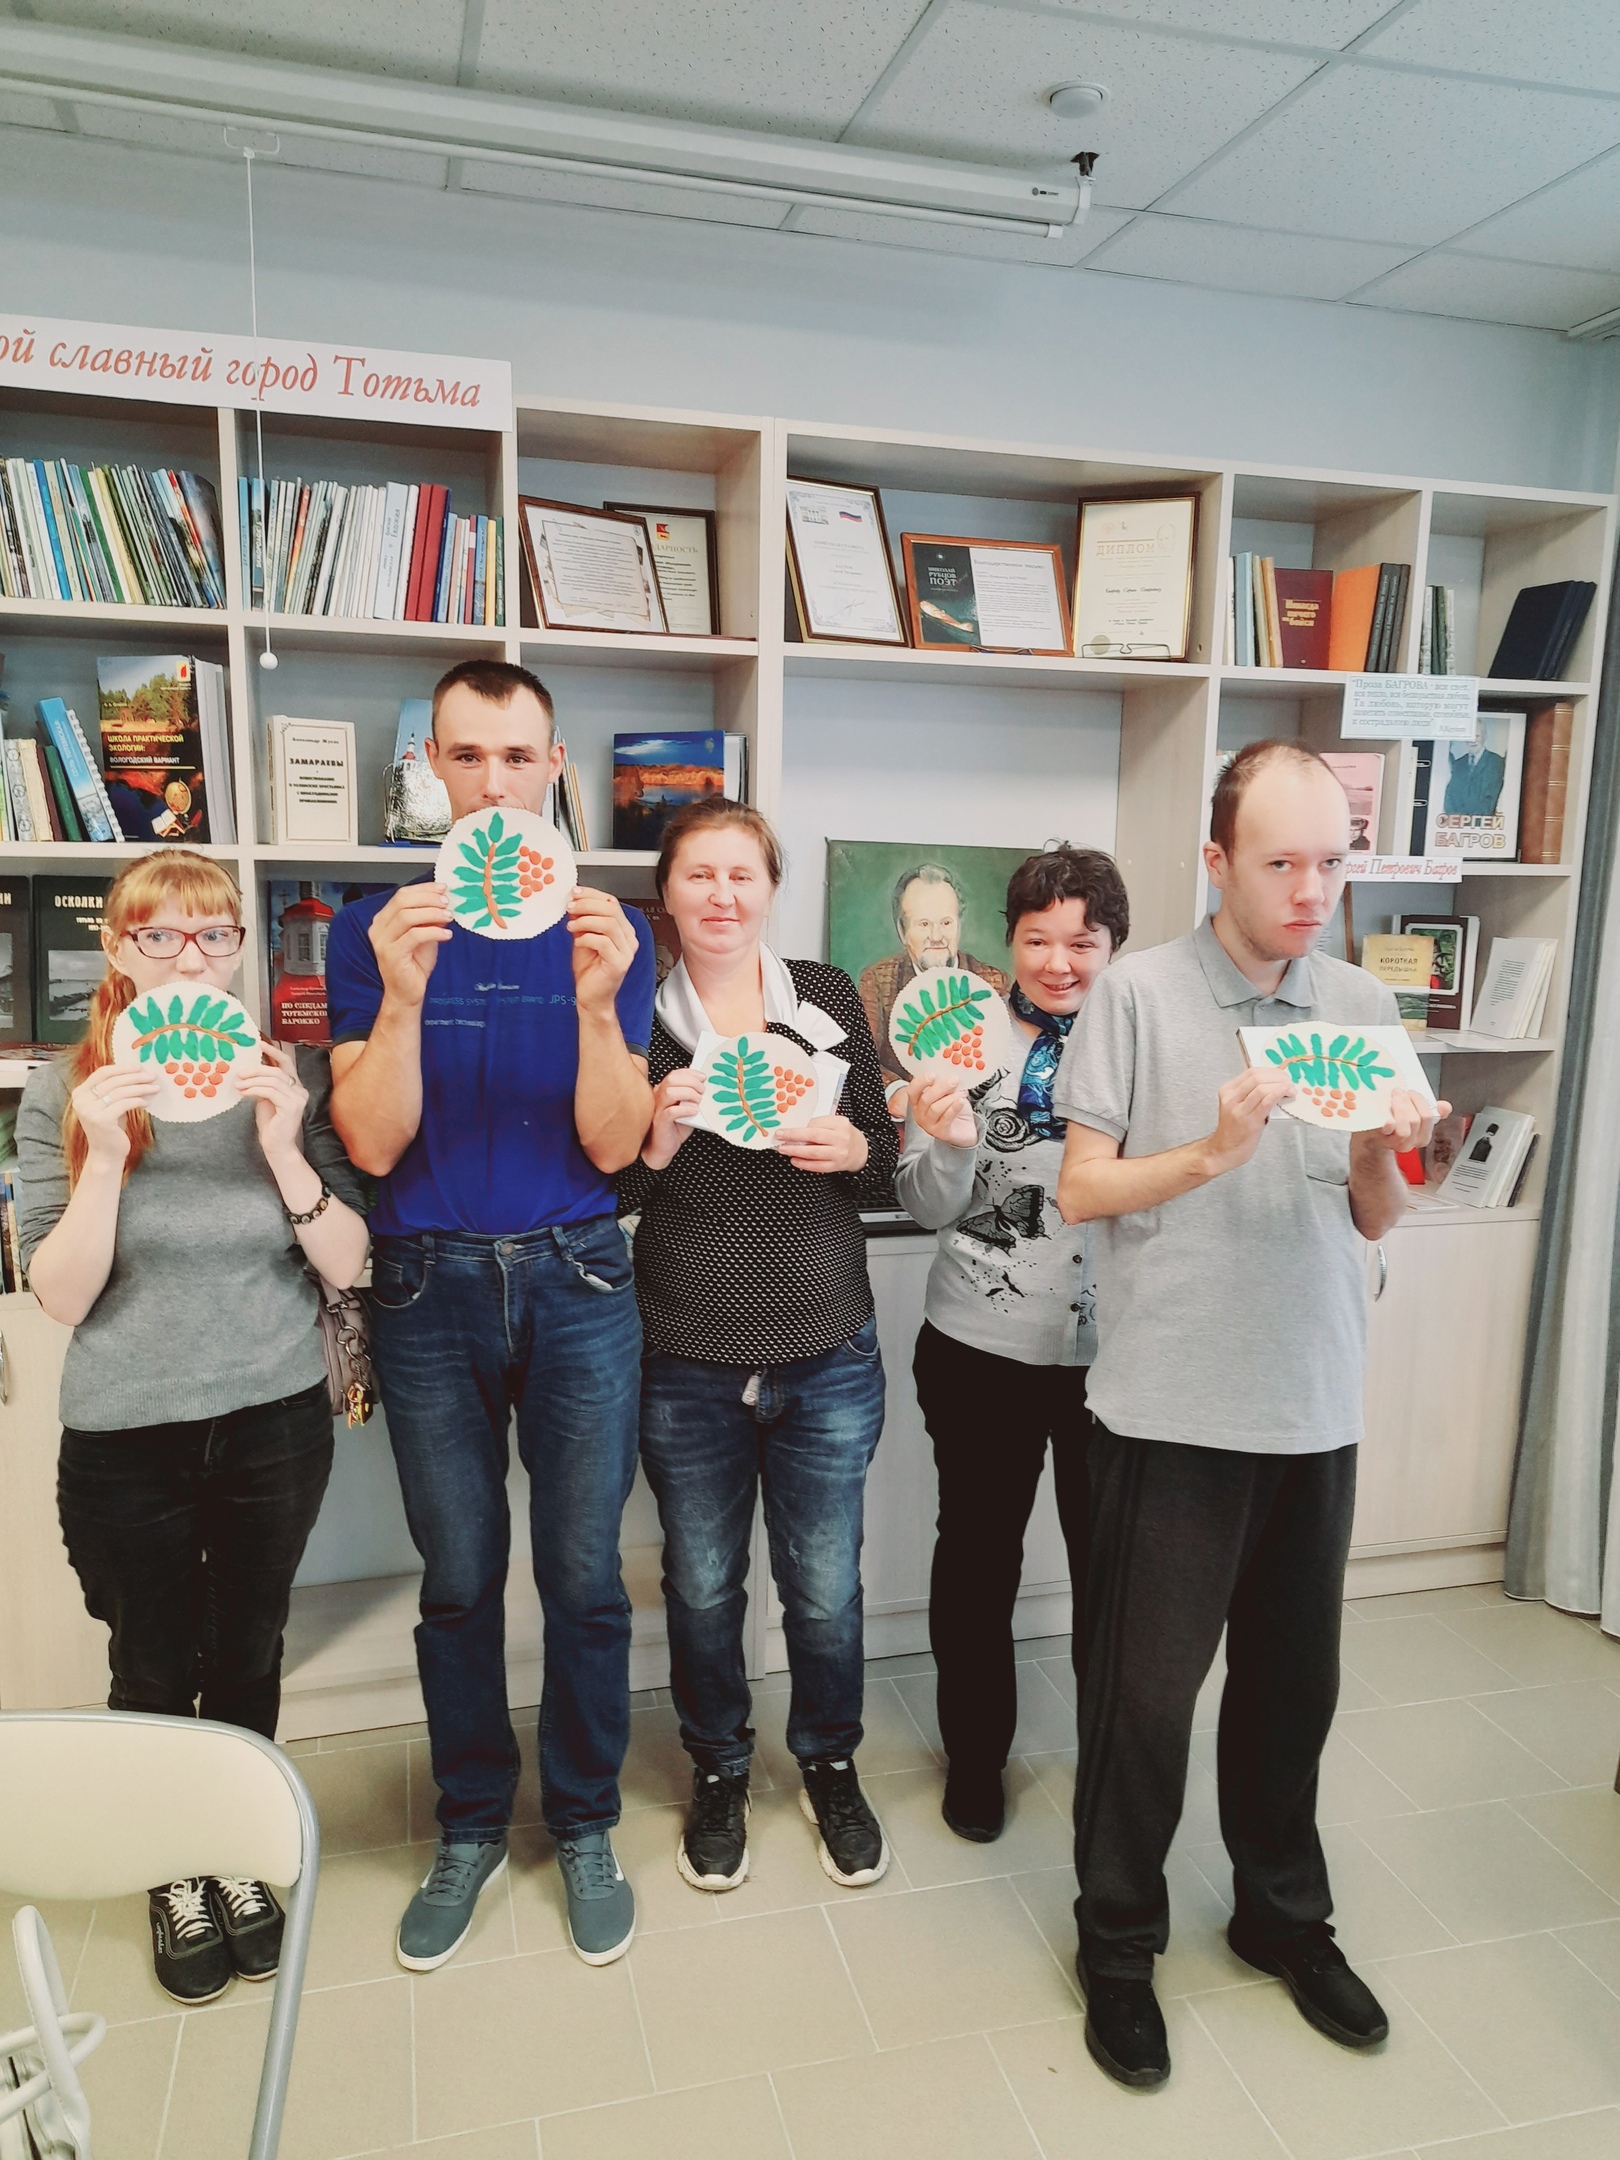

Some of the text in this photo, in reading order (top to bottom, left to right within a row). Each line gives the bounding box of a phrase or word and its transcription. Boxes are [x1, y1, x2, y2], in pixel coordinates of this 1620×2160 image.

[49, 342, 214, 382] славный
[225, 353, 318, 401] город
[333, 354, 481, 407] Тотьма
[1096, 543, 1155, 556] ДИПЛОМ
[929, 577, 959, 587] ПОЭТ
[1385, 679, 1429, 689] БАГРОВА
[1354, 698, 1365, 707] Та
[107, 733, 185, 743] ШКОЛА ПРАКТИЧЕСКОЙ
[108, 744, 146, 752] ЭКОЛОГИИ:
[109, 755, 180, 765] ВОЛОГОДСКИЙ ВАРИАНТ
[289, 758, 344, 767] ЗАМАРАЕВЫ
[1436, 811, 1505, 830] СЕРГЕЙ
[1435, 831, 1506, 849] БАГРОВ
[1368, 858, 1422, 879] Петрович
[1423, 859, 1458, 880] Багров
[54, 895, 104, 909] ОСКОЛКИ
[1379, 957, 1418, 965] КОРОТКАЯ
[1379, 965, 1418, 973] ПЕРЕДЫШКА
[294, 1002, 328, 1010] СЛЕДАМ
